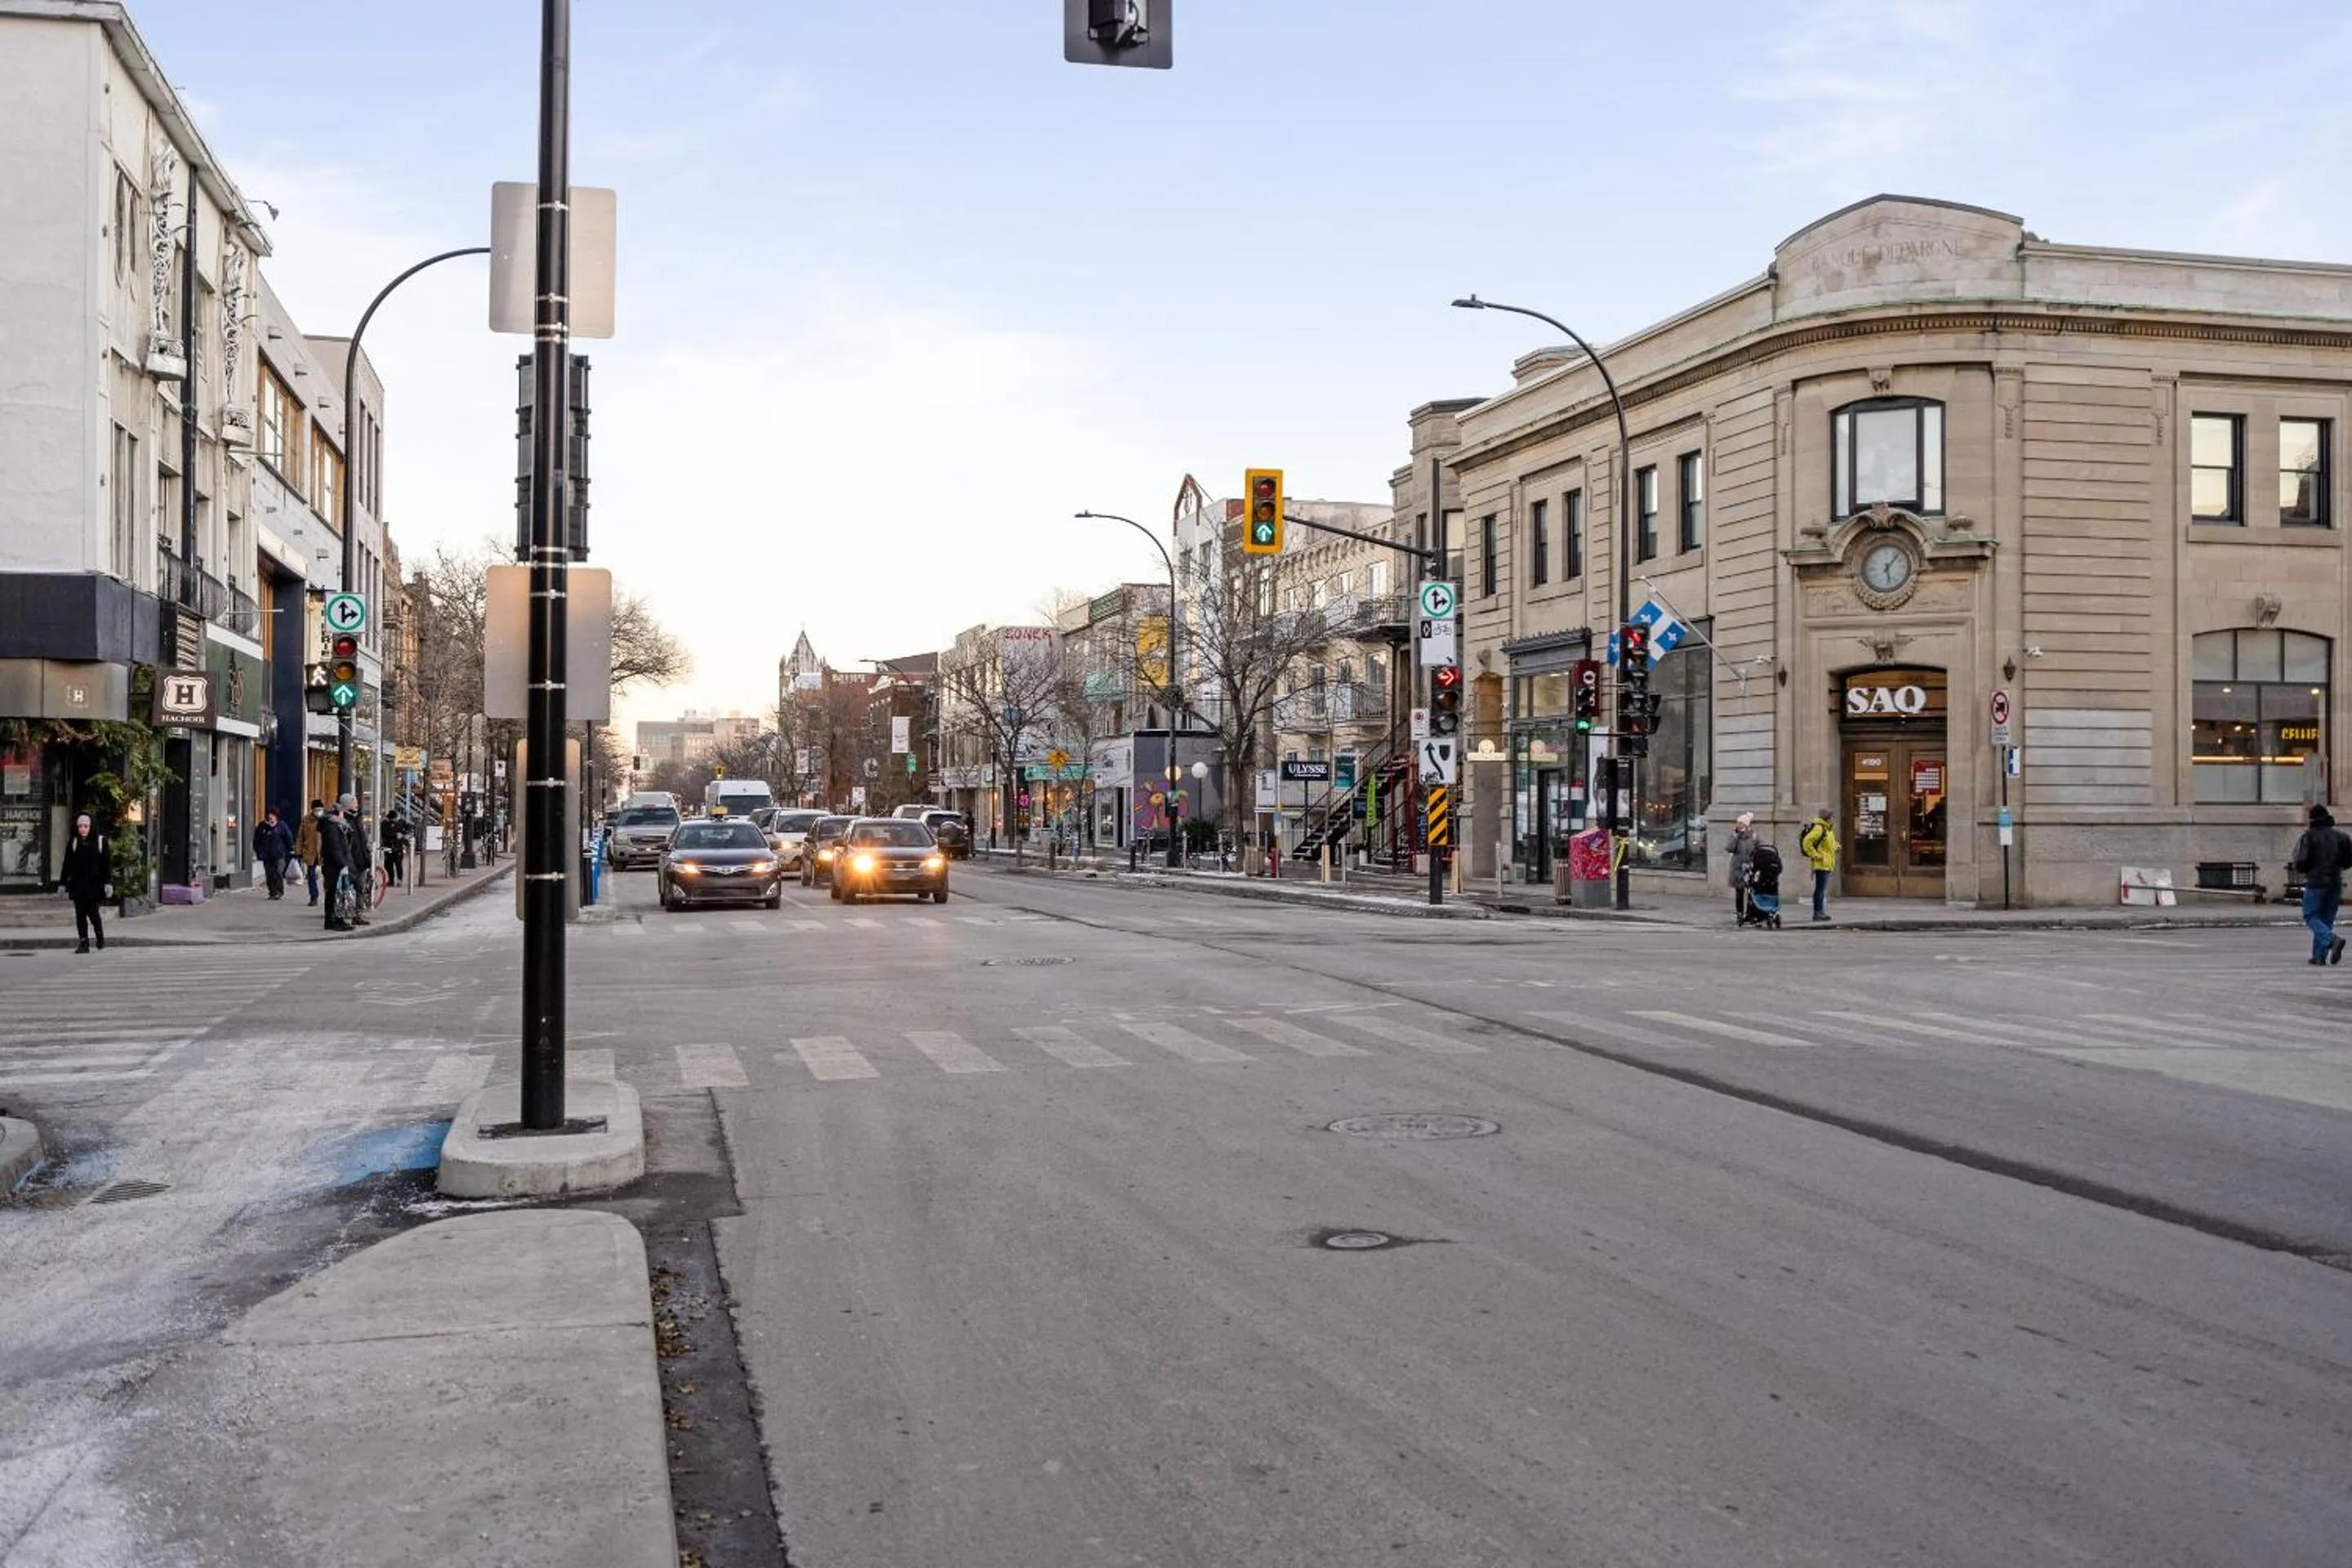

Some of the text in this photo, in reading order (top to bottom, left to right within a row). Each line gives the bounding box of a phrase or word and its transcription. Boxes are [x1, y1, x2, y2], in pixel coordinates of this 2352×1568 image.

[175, 685, 196, 704] H
[1847, 685, 1926, 714] SAQ
[1288, 764, 1327, 773] ULYSSE
